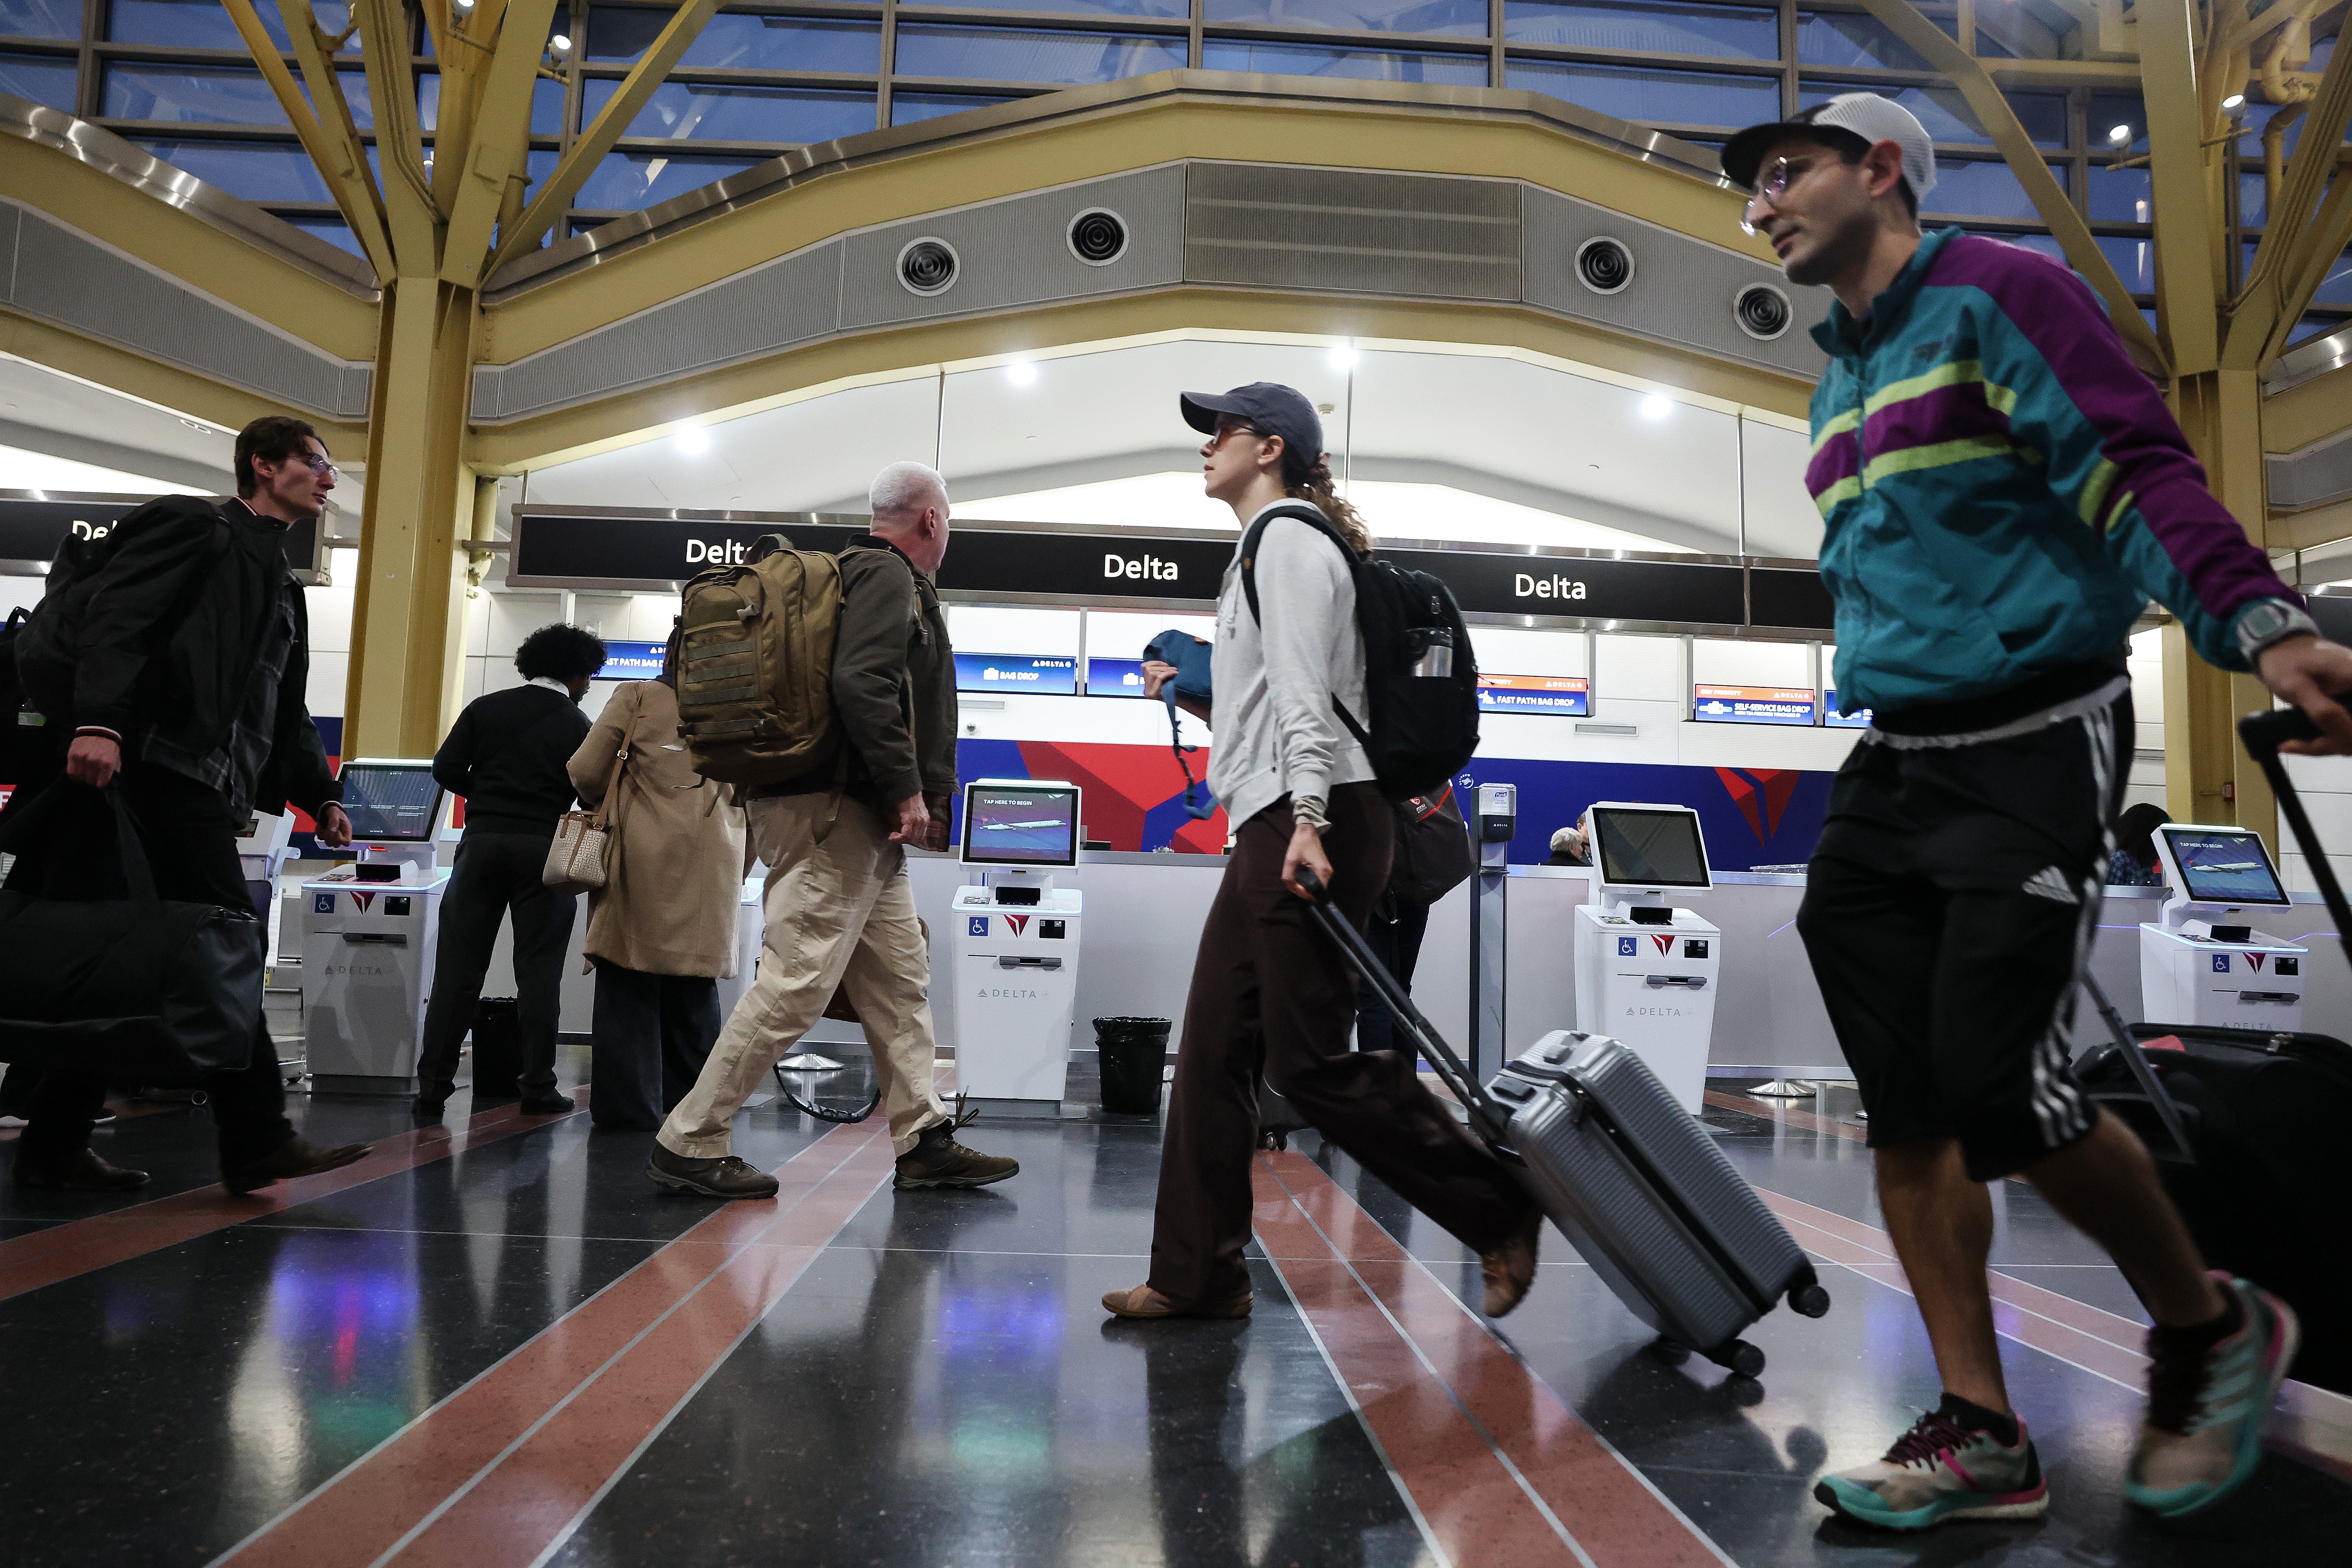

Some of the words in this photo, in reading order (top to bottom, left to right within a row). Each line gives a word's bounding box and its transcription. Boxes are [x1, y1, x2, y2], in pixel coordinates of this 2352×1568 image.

[686, 539, 752, 564] Delt
[1104, 554, 1178, 580] Delta
[1515, 573, 1586, 599] Delta
[620, 658, 641, 666] PATH
[641, 659, 657, 667] BAG
[1000, 671, 1016, 680] BAG
[1017, 672, 1039, 681] DROP
[1497, 696, 1516, 704] FAST
[1516, 696, 1537, 705] PATH
[1538, 697, 1553, 706] BAG
[1554, 698, 1575, 707] DROP
[1734, 702, 1777, 711] SELF-SERVICE
[339, 965, 382, 975] DELTA
[993, 989, 1036, 998] DELTA
[1639, 1007, 1681, 1016] DELTA
